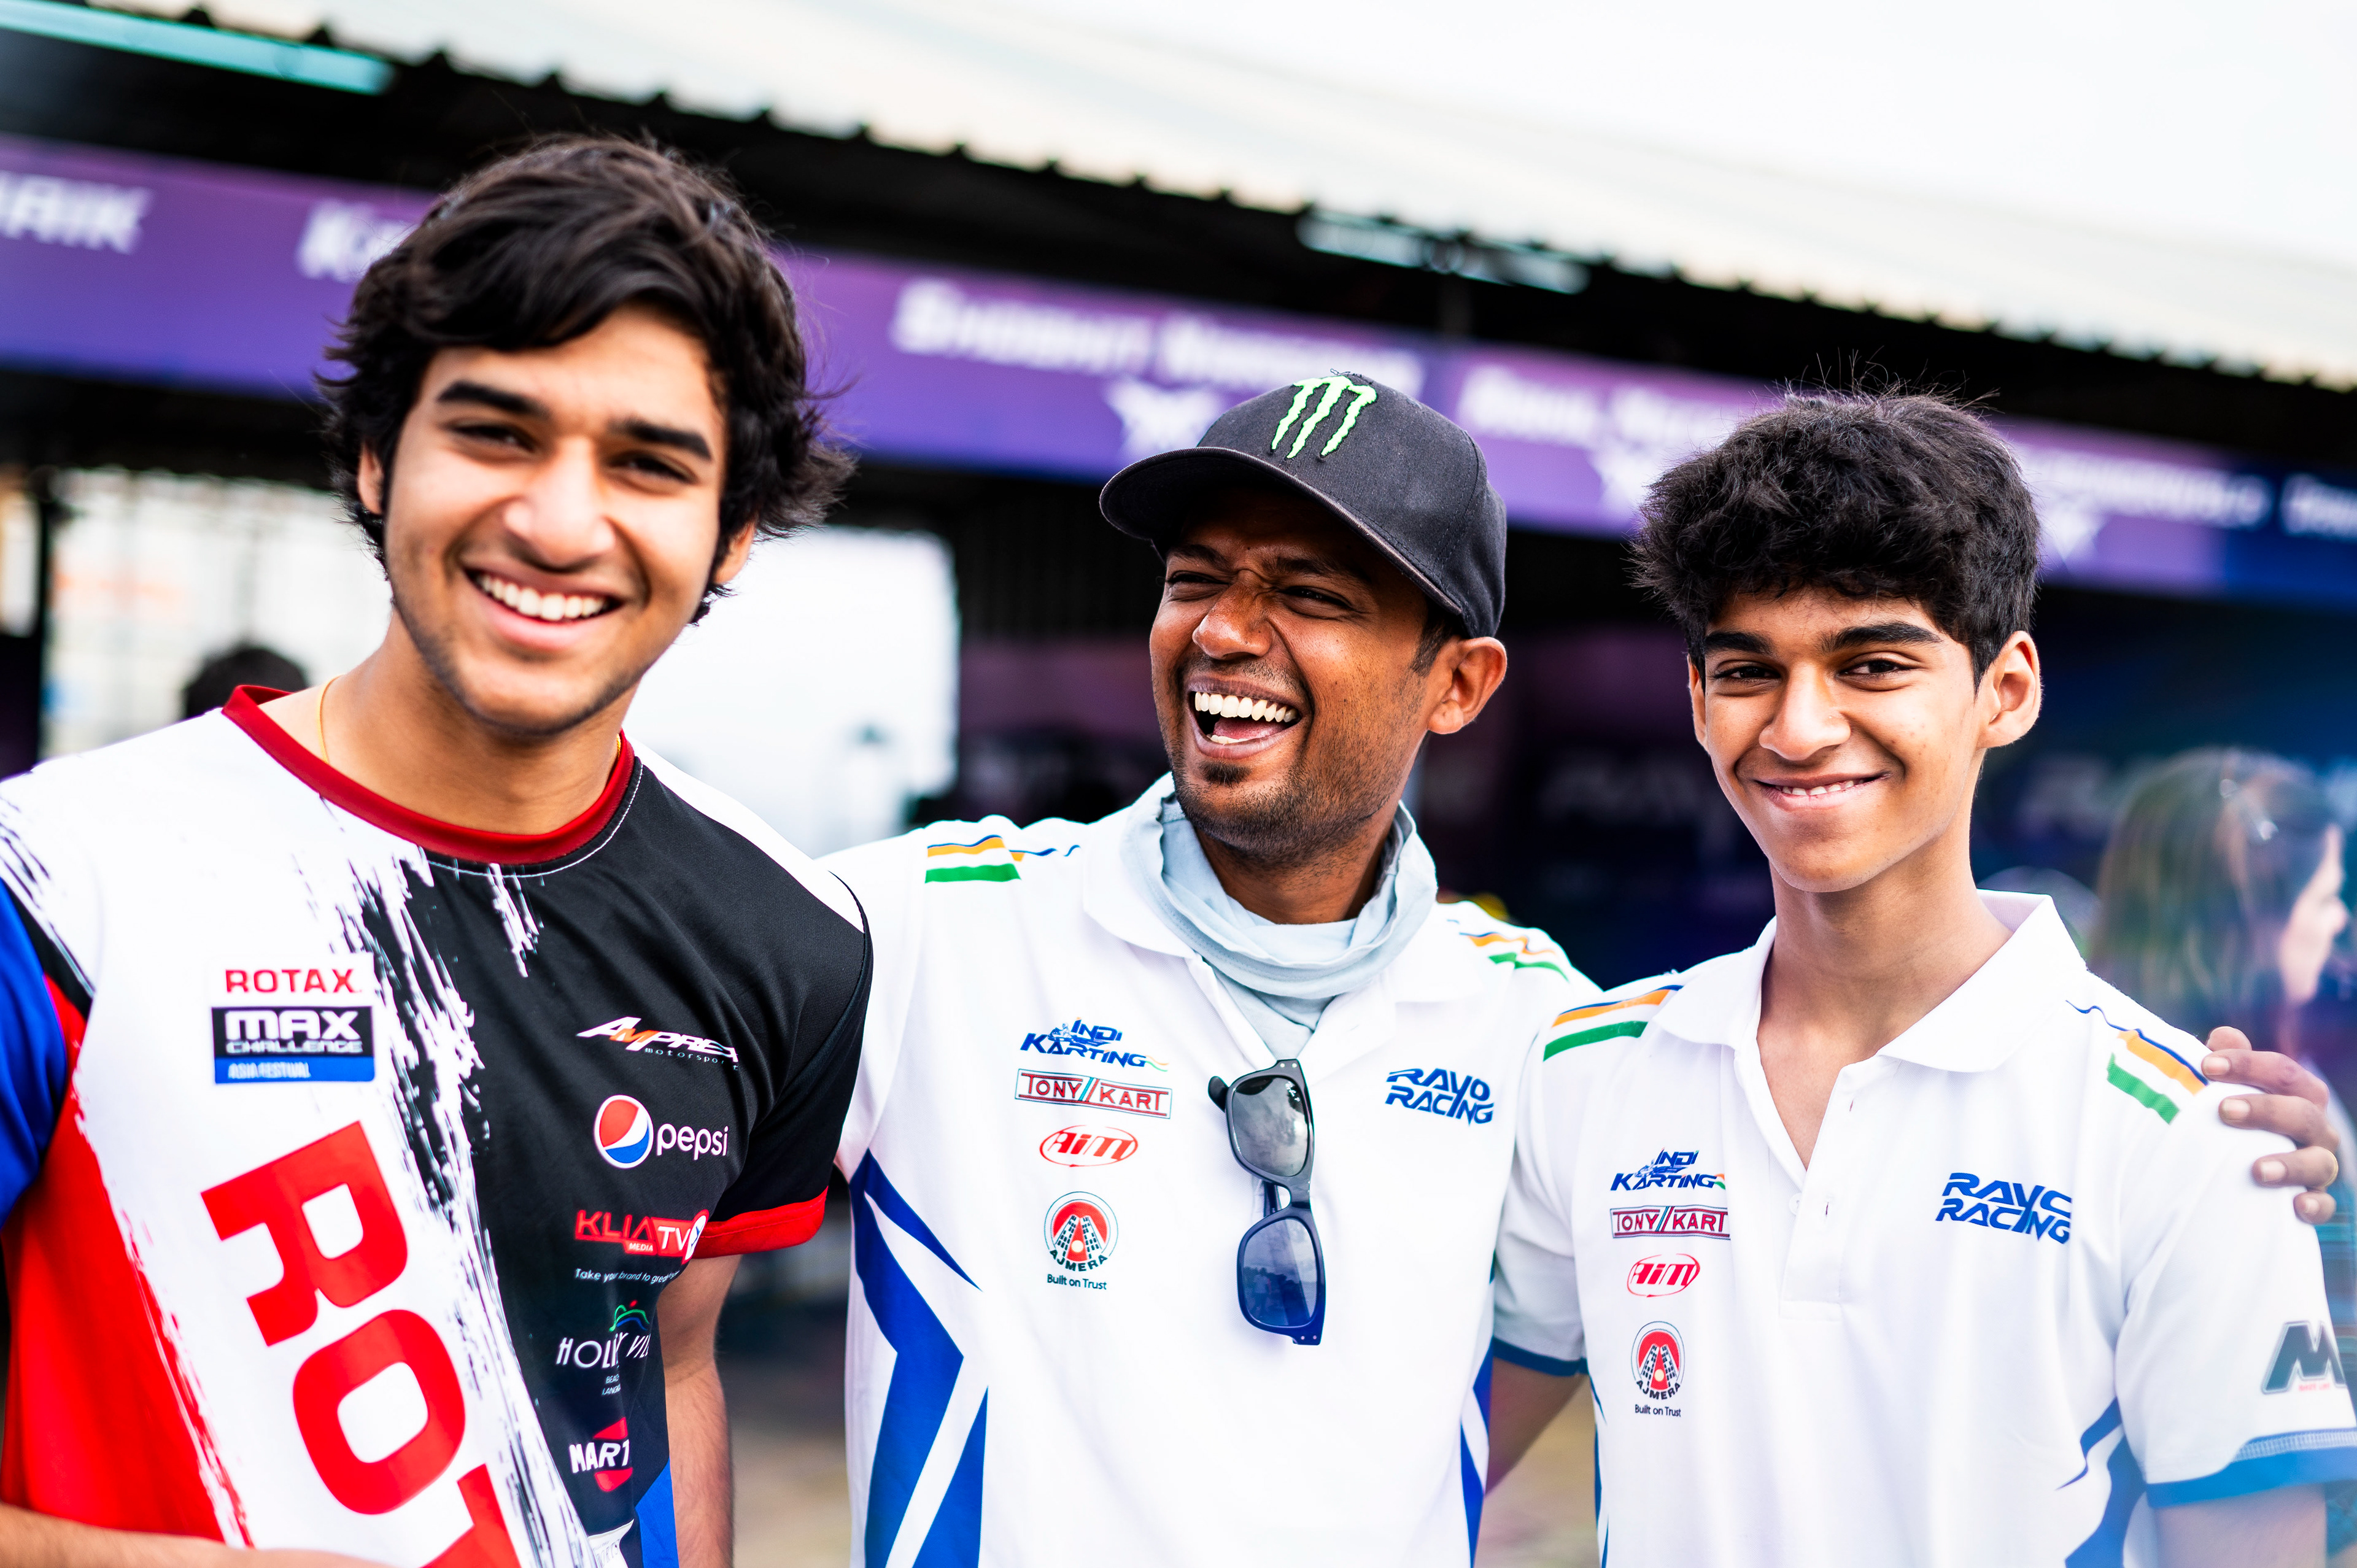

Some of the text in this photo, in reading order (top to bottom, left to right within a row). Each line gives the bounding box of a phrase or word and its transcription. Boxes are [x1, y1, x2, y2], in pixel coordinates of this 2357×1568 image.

[225, 968, 355, 994] ROTAX
[225, 1010, 361, 1040] MAX
[1020, 1033, 1147, 1068] KARTING
[1021, 1073, 1169, 1111] TONY KART
[1385, 1084, 1495, 1127] RACING
[656, 1124, 729, 1161] pepsi
[1610, 1173, 1717, 1191] KARTING
[1613, 1208, 1728, 1232] TONY KART
[1935, 1198, 2071, 1245] RACING
[629, 1243, 653, 1252] MEDIA
[1050, 1249, 1108, 1272] AJMERA
[575, 1268, 601, 1281] Take
[618, 1270, 643, 1281] brand
[642, 1272, 651, 1281] to
[1047, 1273, 1107, 1290] Built on Trust
[1636, 1380, 1681, 1400] AJMERA
[1635, 1404, 1651, 1415] Built
[1664, 1406, 1681, 1417] Trust
